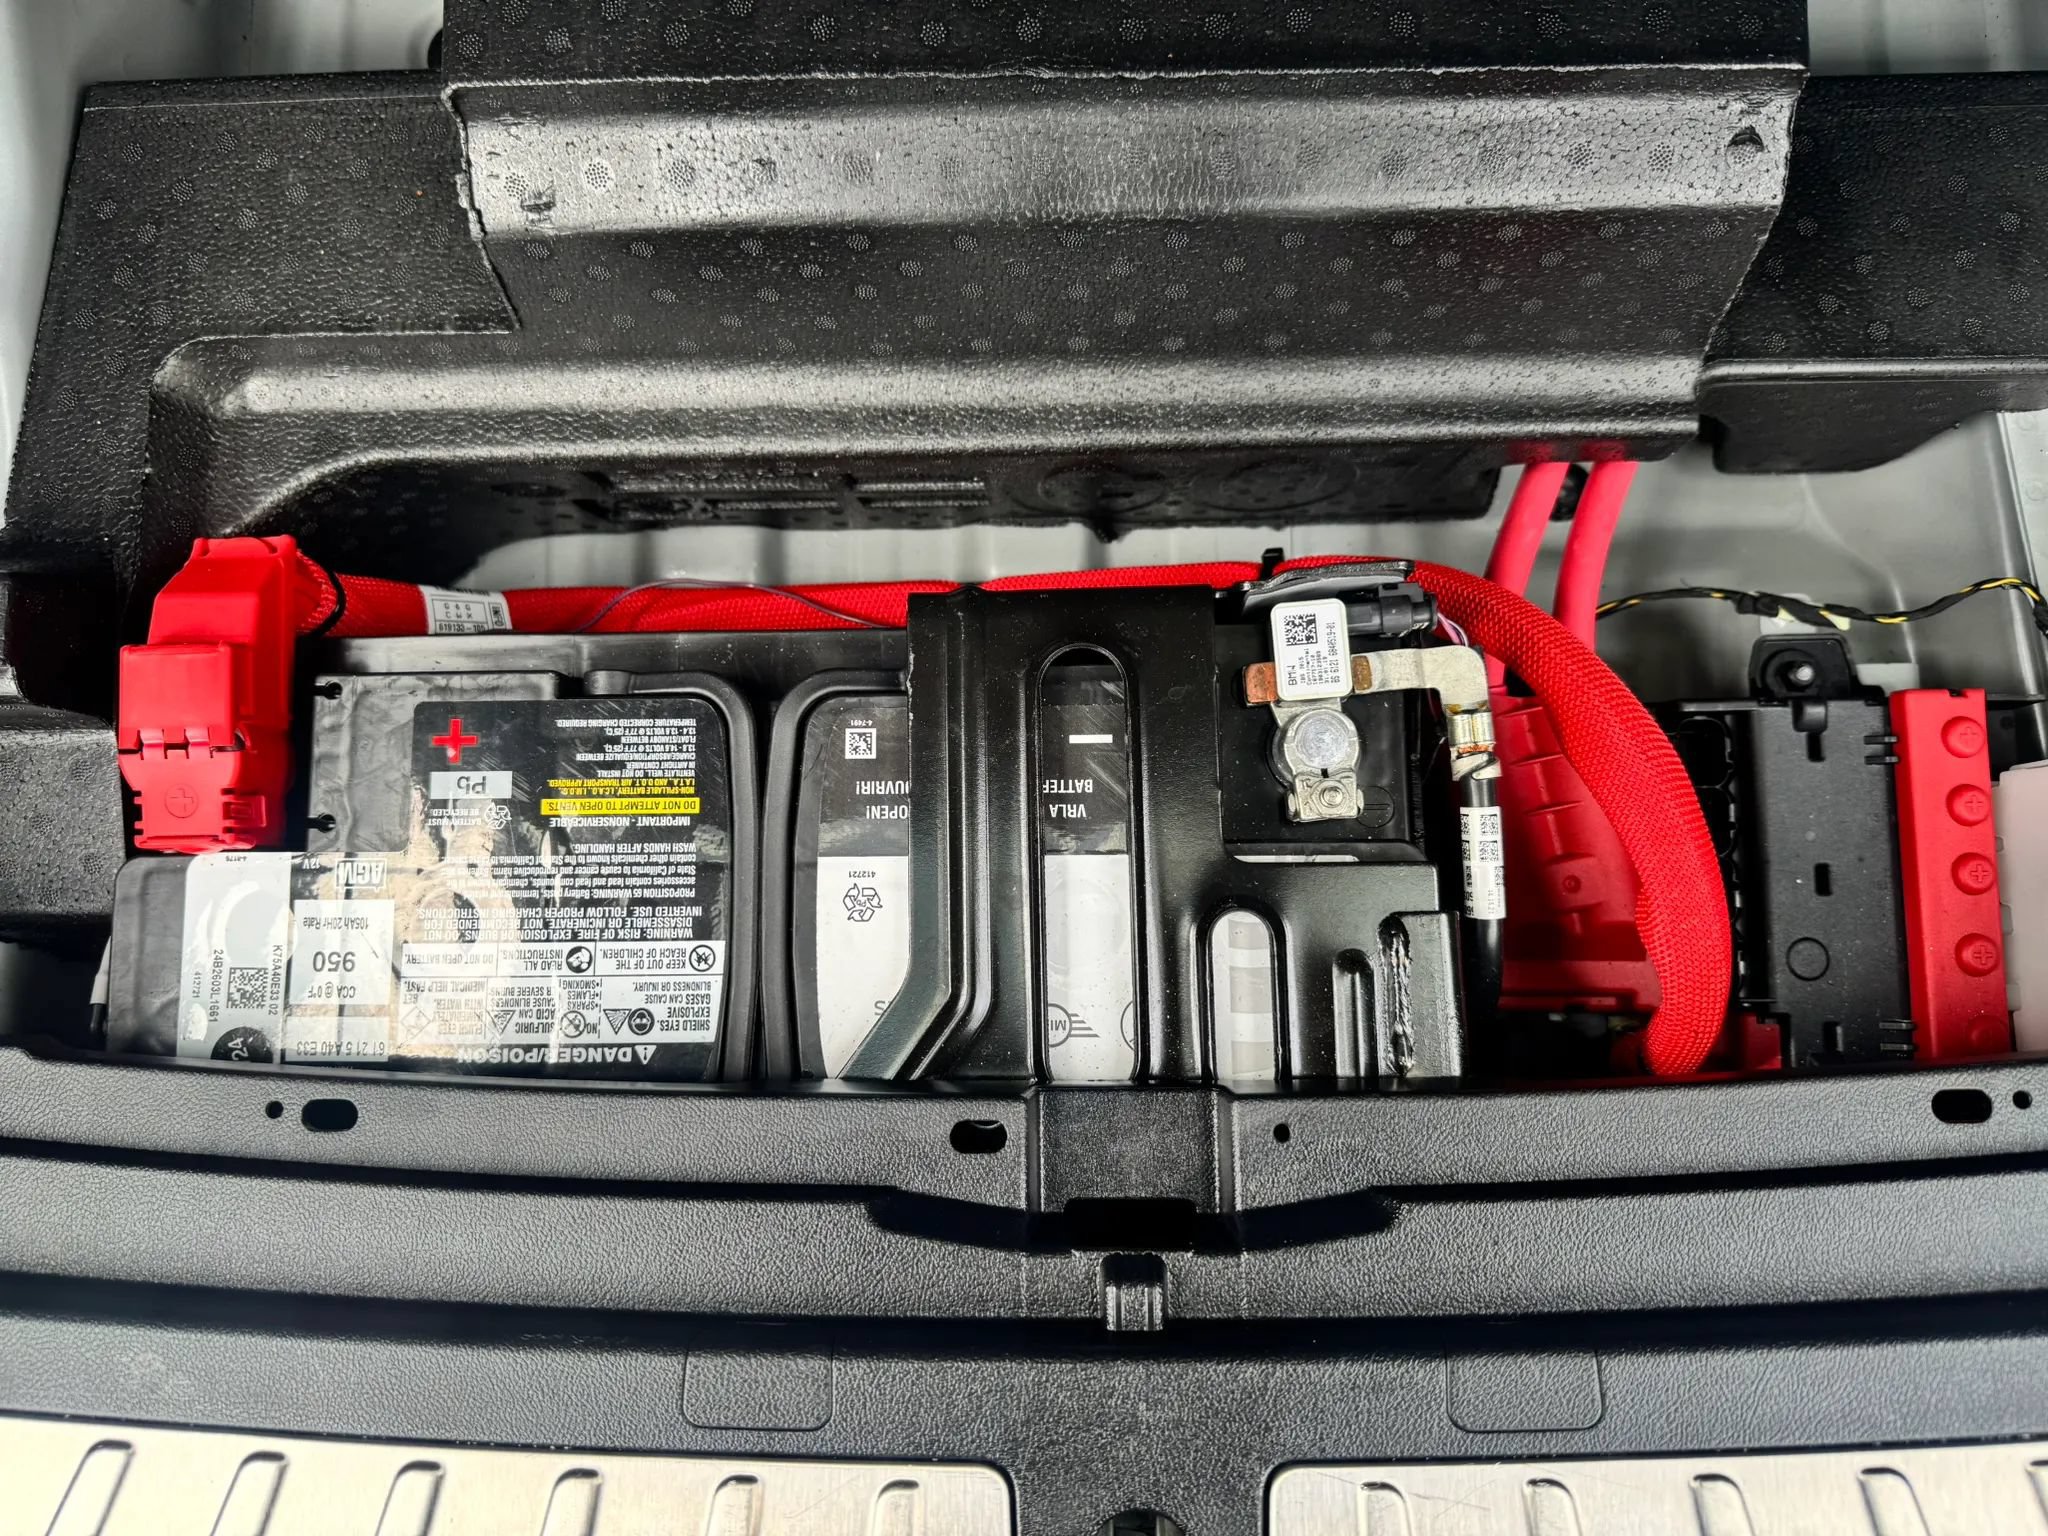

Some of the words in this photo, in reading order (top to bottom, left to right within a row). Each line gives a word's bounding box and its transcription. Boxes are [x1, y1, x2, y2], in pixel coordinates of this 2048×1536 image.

[1286, 665, 1298, 686] BMW
[555, 719, 587, 727] REQUIRED.
[618, 718, 654, 726] CORRECTED
[650, 736, 696, 744] FLOAT/STANDBY
[456, 776, 486, 794] Pb
[546, 778, 582, 787] APPROVED.
[582, 778, 620, 786] TRANSPORT
[620, 778, 632, 786] AIR
[546, 802, 578, 811] VENTS.
[580, 801, 604, 810] OPEN
[606, 801, 616, 810] TO
[619, 800, 660, 810] ATTEMPT
[662, 800, 680, 810] NOT
[684, 800, 696, 810] DO
[866, 805, 908, 820] OPEN!
[1049, 804, 1086, 818] VRLA
[549, 816, 630, 828] NONSERVICEABLE
[636, 816, 690, 826] IMPORTANT
[572, 844, 615, 854] HANDLING.
[616, 844, 642, 853] AFTER
[643, 843, 670, 852] HANDS
[672, 842, 696, 852] WASH
[498, 856, 534, 864] California
[565, 856, 576, 864] the
[578, 855, 585, 864] to
[586, 855, 610, 864] known
[611, 854, 648, 864] chemicals
[650, 854, 668, 864] other
[670, 854, 696, 863] contain
[338, 862, 384, 884] AGM
[560, 866, 574, 875] and
[575, 866, 599, 874] cancer
[600, 866, 622, 874] cause
[624, 866, 631, 874] to
[632, 866, 667, 875] California
[668, 866, 676, 874] of
[678, 865, 696, 874] State
[575, 878, 591, 886] lead
[593, 878, 606, 886] and
[608, 878, 624, 886] lead
[626, 877, 652, 886] contain
[654, 877, 696, 886] accessories
[566, 887, 590, 898] Battery
[591, 888, 632, 898] WARNING:
[633, 888, 642, 898] 65
[642, 888, 695, 898] PROPOSITION
[492, 908, 542, 918] CHARGING
[545, 907, 584, 918] PROPER
[586, 906, 627, 917] FOLLOW
[630, 906, 652, 916] USE.
[655, 906, 702, 916] INVERTED
[302, 917, 321, 930] Rate
[344, 917, 368, 930] 105Ah
[424, 920, 444, 930] FOR
[447, 918, 520, 930] RECOMMENDED
[522, 918, 543, 929] NOT
[546, 918, 606, 928] INCINERATE.
[608, 918, 622, 928] OR
[624, 917, 692, 928] DISASSEMBLE
[423, 930, 442, 941] NOT
[446, 930, 458, 940] DO
[462, 930, 498, 940] BURNS.
[500, 930, 516, 940] OR
[520, 929, 572, 940] EXPLOSION
[602, 928, 614, 939] OF
[618, 928, 640, 939] RISK
[643, 928, 692, 939] WARNING:
[600, 948, 644, 958] CHILDREN.
[646, 948, 656, 958] OF
[660, 948, 686, 958] REACH
[312, 951, 356, 972] 950
[404, 954, 440, 964] BATTERY.
[442, 954, 462, 964] OPEN
[464, 954, 480, 964] NOT
[482, 954, 493, 964] DO
[646, 959, 664, 969] OUT
[666, 959, 686, 969] KEEP
[524, 960, 538, 970] ALL
[616, 960, 631, 970] THE
[634, 960, 644, 969] OF
[324, 982, 334, 998] @
[517, 986, 544, 996] SEVERE
[632, 982, 659, 992] INJURY.
[660, 982, 670, 991] OR
[672, 981, 711, 991] BLINDNESS
[336, 986, 356, 998] CCA
[644, 994, 667, 1004] CAUSE
[670, 994, 683, 1003] CAN
[686, 994, 710, 1004] GASES
[519, 1009, 533, 1019] CAN
[536, 1008, 555, 1020] ACID
[668, 1007, 710, 1018] EXPLOSIVE
[515, 1022, 554, 1033] SULFURIC
[586, 1023, 598, 1034] NO
[657, 1020, 680, 1031] EYES.
[682, 1020, 710, 1031] SHIELD
[227, 1037, 248, 1060] 24
[296, 1042, 317, 1056] E33
[320, 1042, 343, 1056] A40
[346, 1042, 352, 1056] 5
[356, 1042, 368, 1056] 21
[373, 1042, 384, 1055] 61
[458, 1047, 632, 1063] DANGER/POISON
